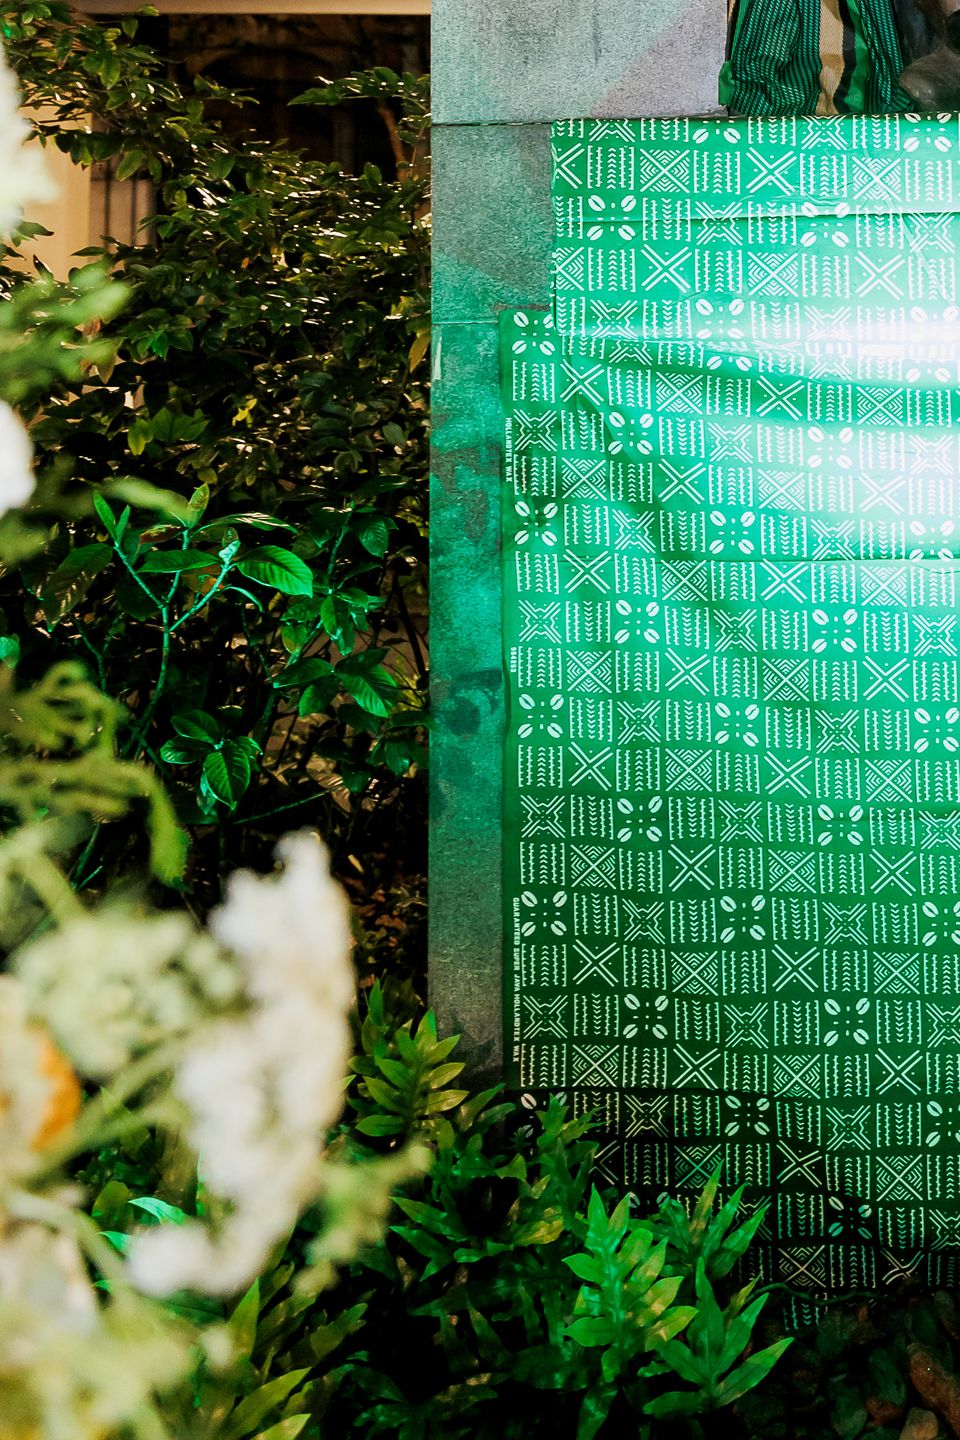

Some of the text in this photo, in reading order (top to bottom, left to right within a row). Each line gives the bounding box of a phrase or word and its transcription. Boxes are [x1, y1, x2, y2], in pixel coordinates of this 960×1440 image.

[505, 417, 513, 482] HOLLANDTEX WAX
[512, 897, 521, 1062] GUARANTEED SUPER JAVA HOLLANDTEX WAX
